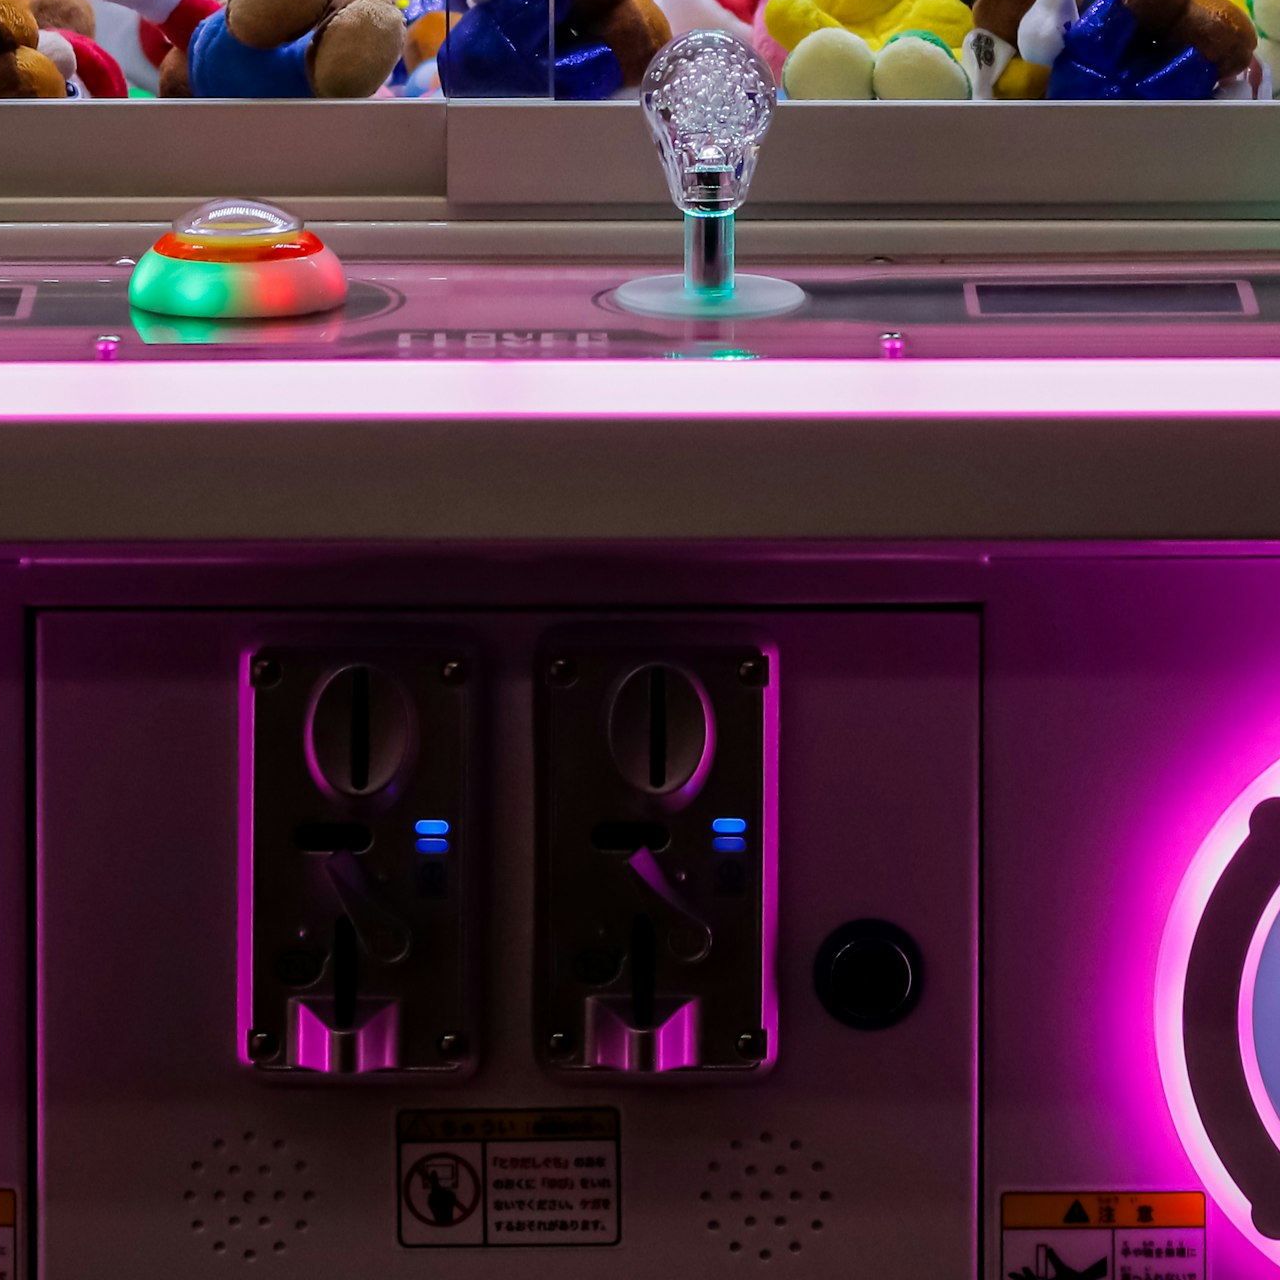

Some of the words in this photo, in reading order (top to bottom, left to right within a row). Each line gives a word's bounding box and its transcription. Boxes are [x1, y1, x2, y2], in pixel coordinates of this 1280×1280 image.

[1099, 1206, 1154, 1223] 注意
[495, 1220, 607, 1232] するおそれがあります。
